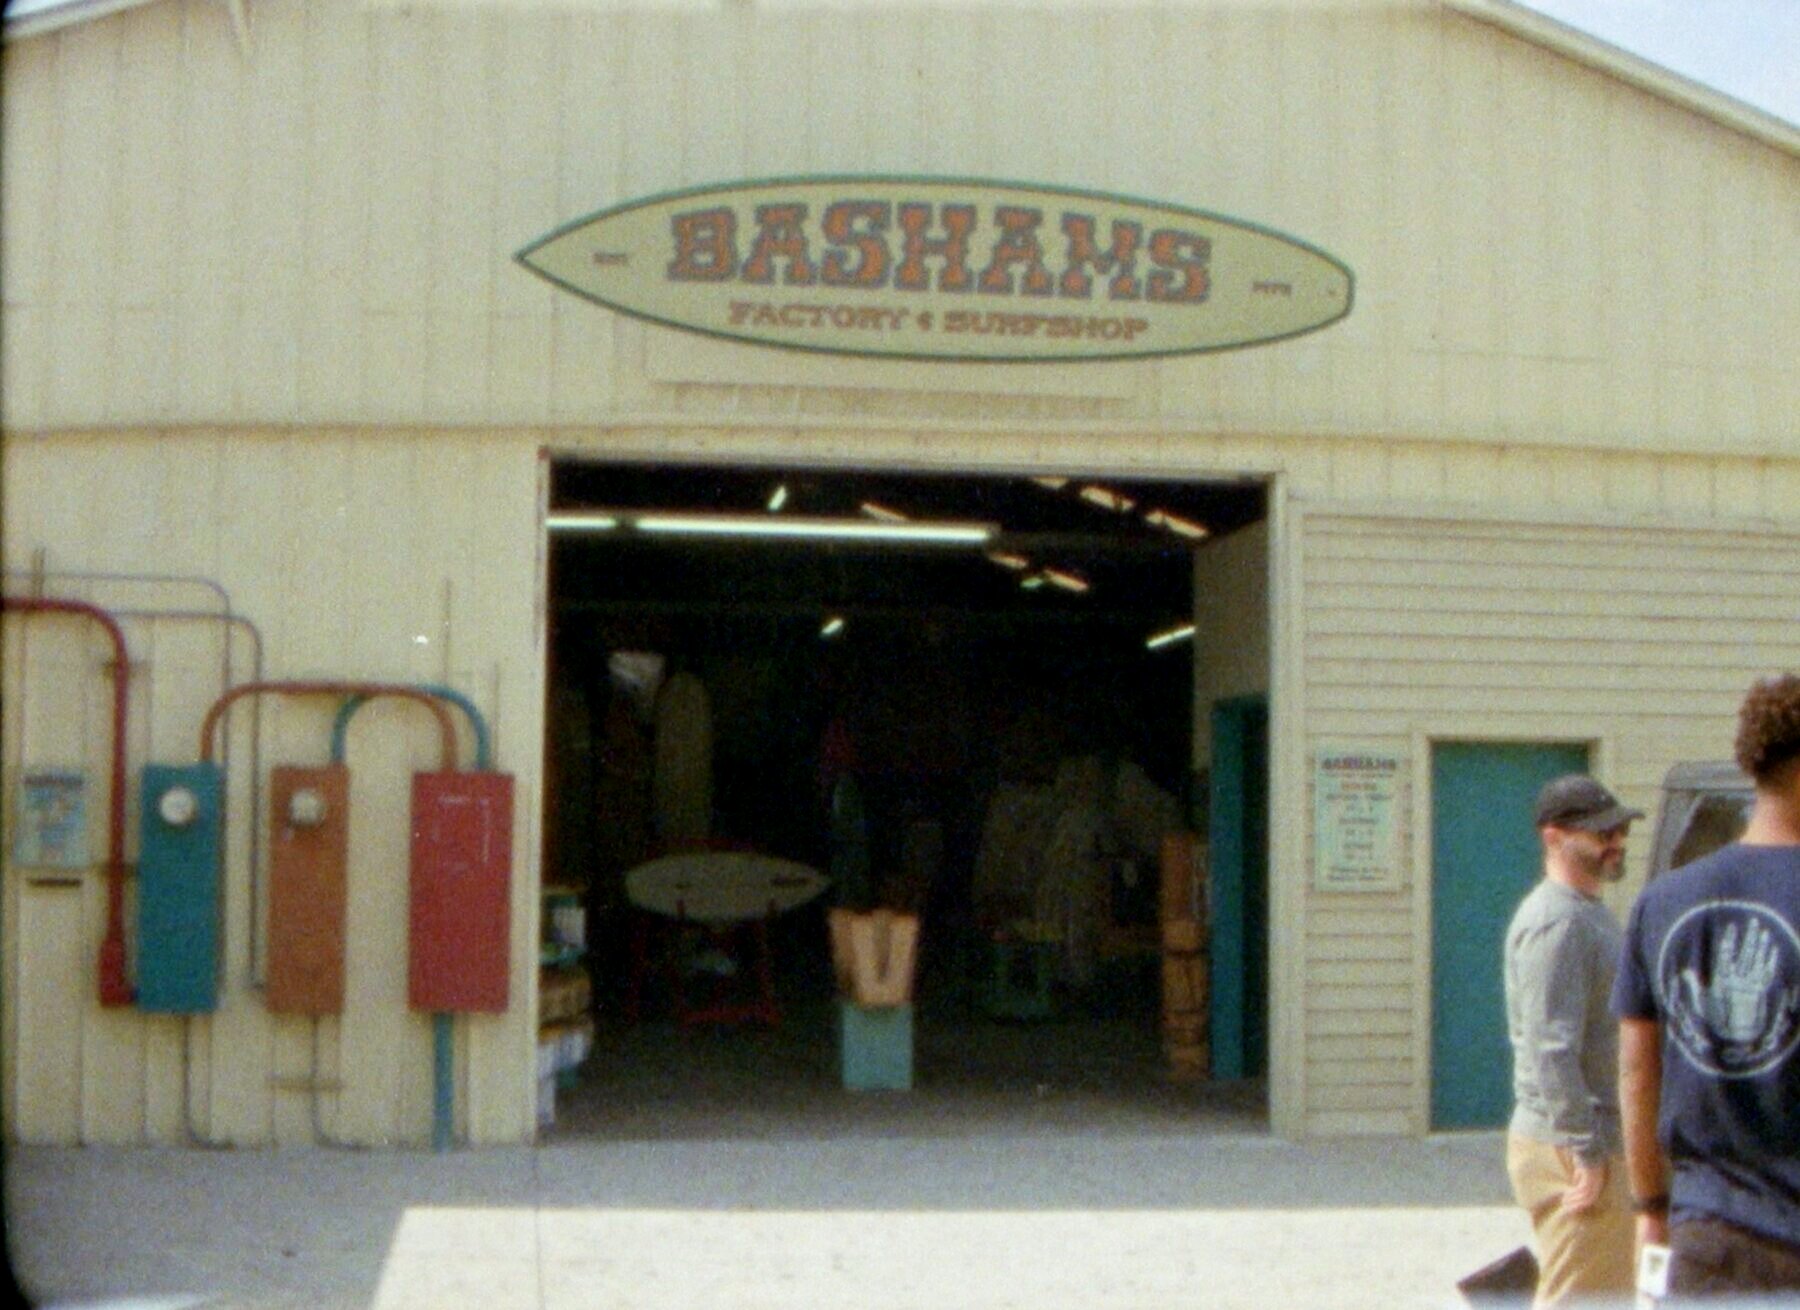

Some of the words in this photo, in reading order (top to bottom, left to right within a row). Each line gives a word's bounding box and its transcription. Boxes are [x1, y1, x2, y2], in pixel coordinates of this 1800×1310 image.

[667, 201, 1211, 303] BASHAMS
[729, 301, 910, 331] FACTORY
[943, 309, 1149, 341] SURFSHOP
